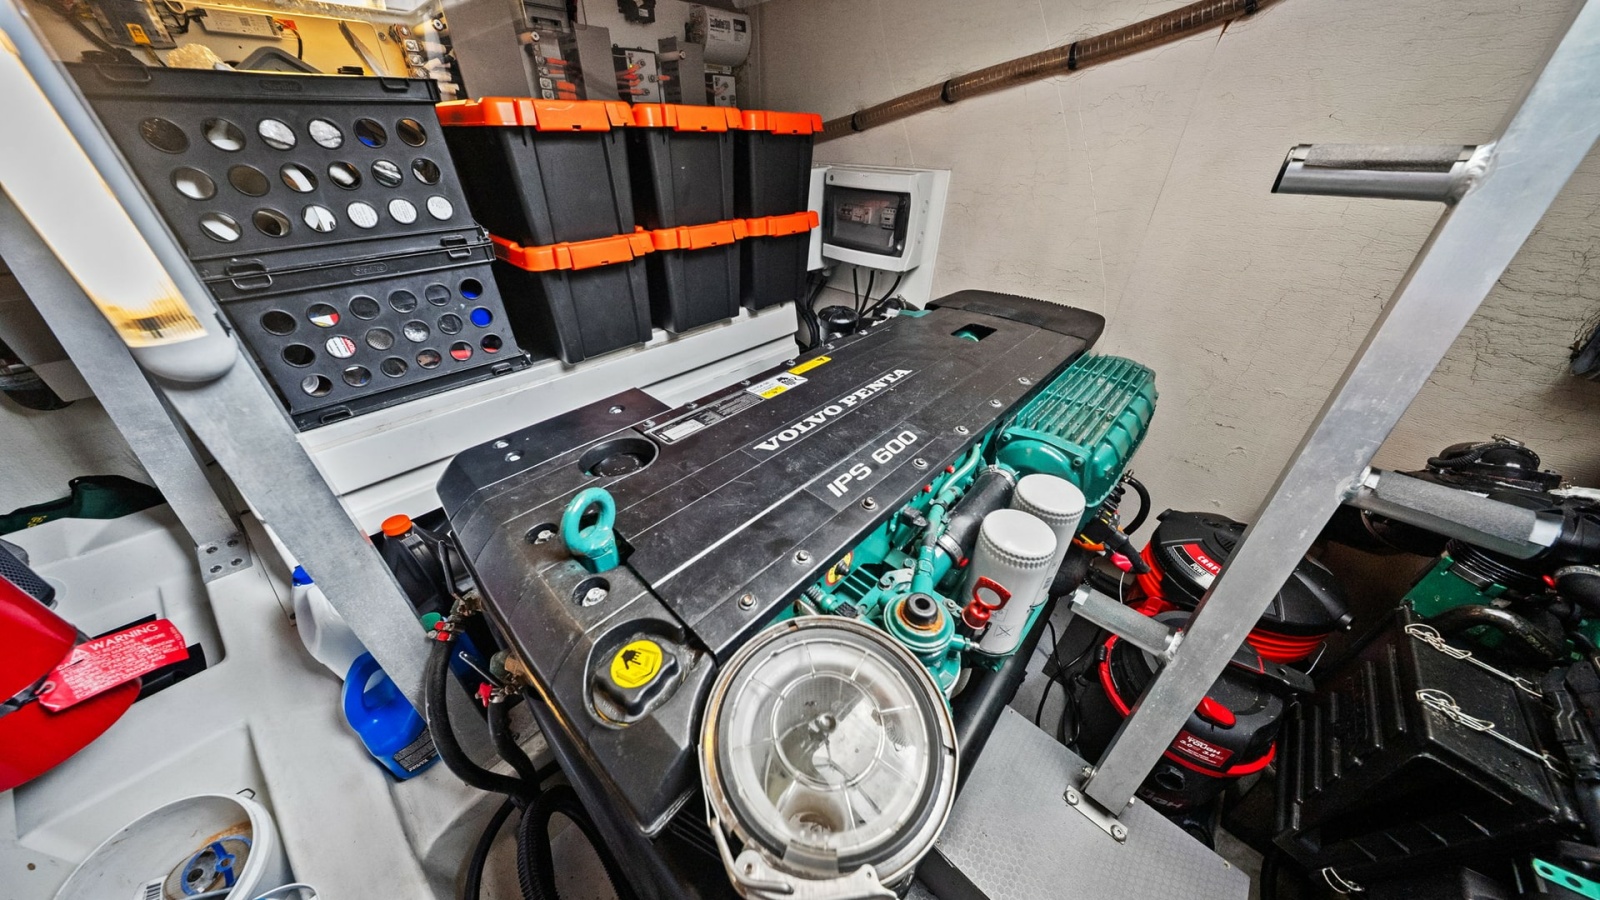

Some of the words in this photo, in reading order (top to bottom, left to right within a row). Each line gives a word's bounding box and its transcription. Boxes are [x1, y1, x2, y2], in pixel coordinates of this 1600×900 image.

[753, 405, 843, 451] VOLVO
[838, 369, 913, 407] PENTA
[826, 463, 872, 498] IPS
[871, 430, 918, 464] 600
[89, 624, 158, 651] WARNING
[1139, 788, 1183, 809] UGH
